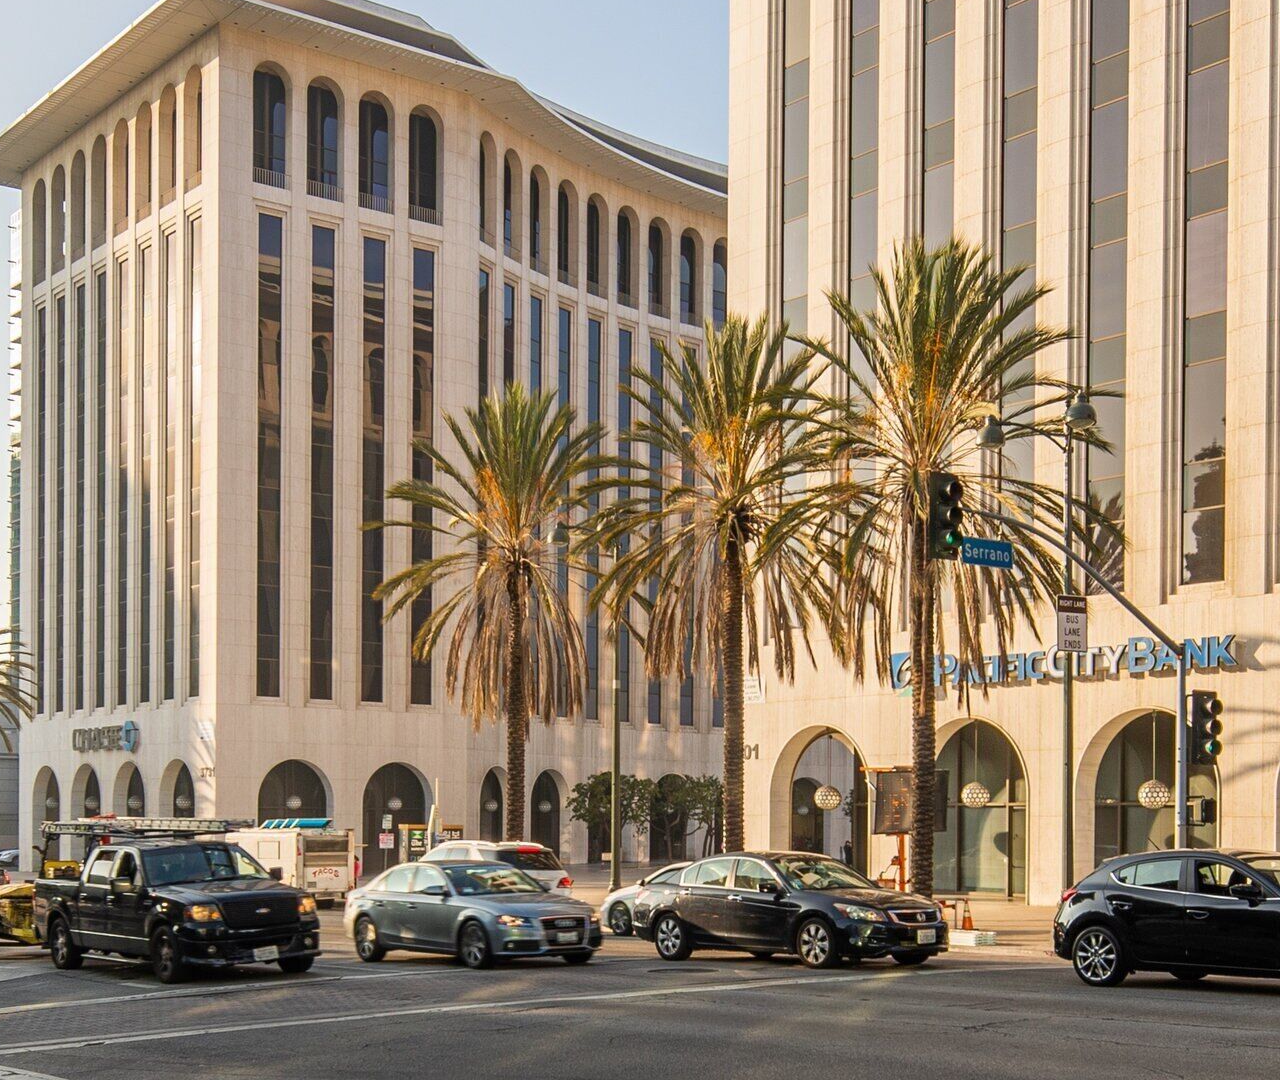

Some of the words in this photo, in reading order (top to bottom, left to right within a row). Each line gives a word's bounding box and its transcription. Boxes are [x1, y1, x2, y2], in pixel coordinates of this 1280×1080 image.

[965, 543, 1010, 562] Serrano
[1066, 615, 1079, 624] BUS
[1064, 628, 1080, 636] LANE
[1064, 641, 1081, 649] ENDS
[1128, 634, 1237, 673] BANK
[73, 725, 122, 753] CHASE
[312, 867, 340, 878] TACOS
